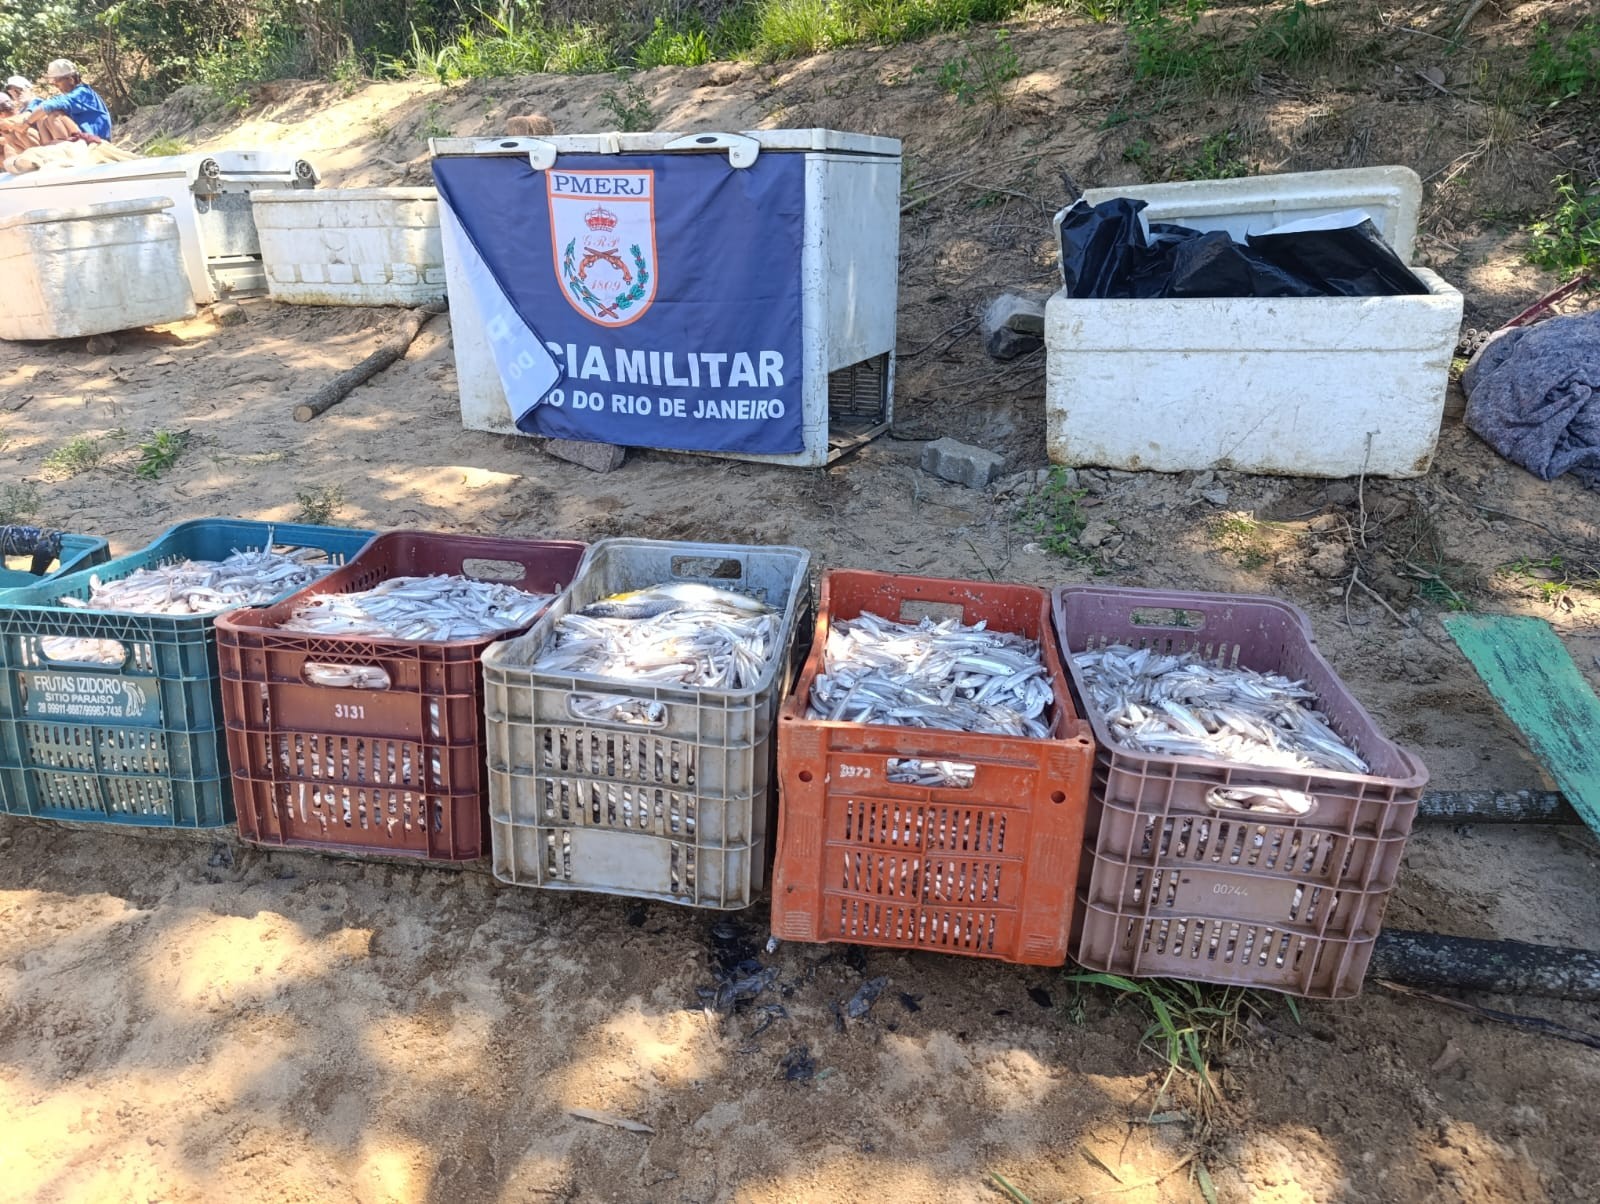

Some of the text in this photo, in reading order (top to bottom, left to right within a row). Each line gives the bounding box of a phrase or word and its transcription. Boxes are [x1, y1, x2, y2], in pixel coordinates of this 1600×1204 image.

[553, 175, 646, 195] PMERJ
[590, 278, 622, 291] 1809
[615, 348, 784, 388] MILITAR
[572, 390, 604, 412] DO
[612, 393, 652, 416] RIO
[659, 397, 688, 418] DE
[693, 398, 786, 420] JANEIRO
[33, 675, 121, 695] FRUTAS IZIDORO
[335, 703, 365, 719] 3131
